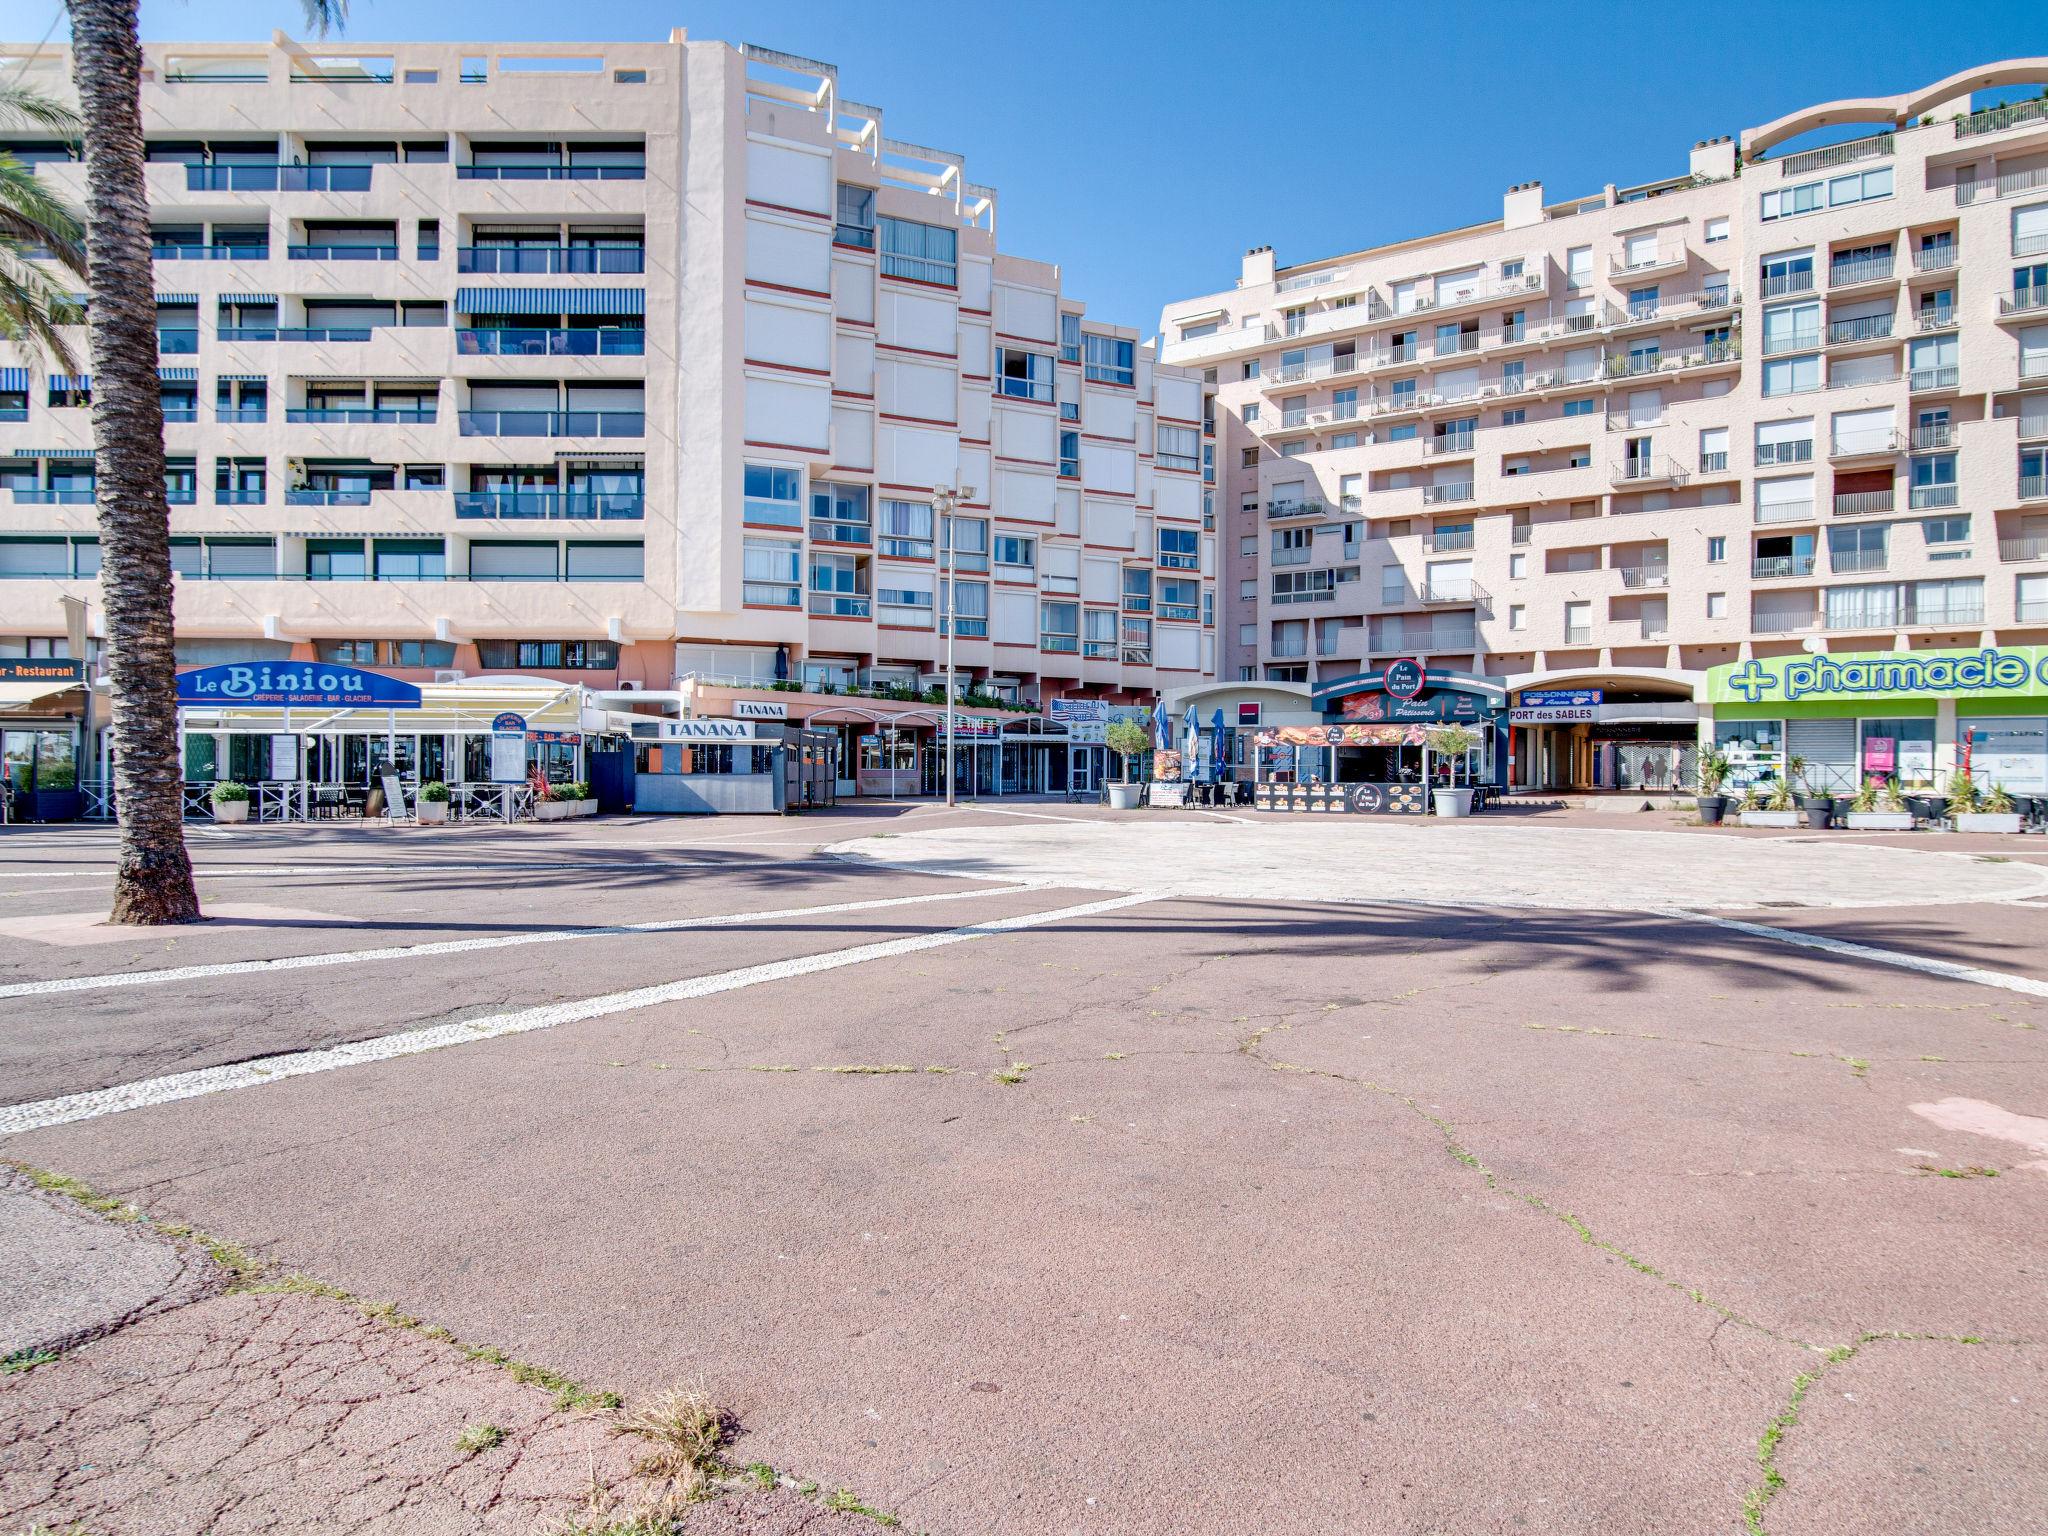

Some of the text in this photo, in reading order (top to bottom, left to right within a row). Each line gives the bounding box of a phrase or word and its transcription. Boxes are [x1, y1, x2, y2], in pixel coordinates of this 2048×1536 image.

[15, 665, 74, 677] Restaurant
[1785, 649, 2029, 699] pharmacie
[195, 667, 364, 697] Le Biniou
[344, 695, 372, 703] GLACIER
[1523, 690, 1592, 698] POISSONNERIE
[1402, 697, 1428, 708] Pain
[738, 704, 783, 716] TANANA
[1395, 708, 1436, 717] Pâtisserie
[1510, 709, 1592, 720] PORT des SABLES
[666, 724, 747, 737] TANANA
